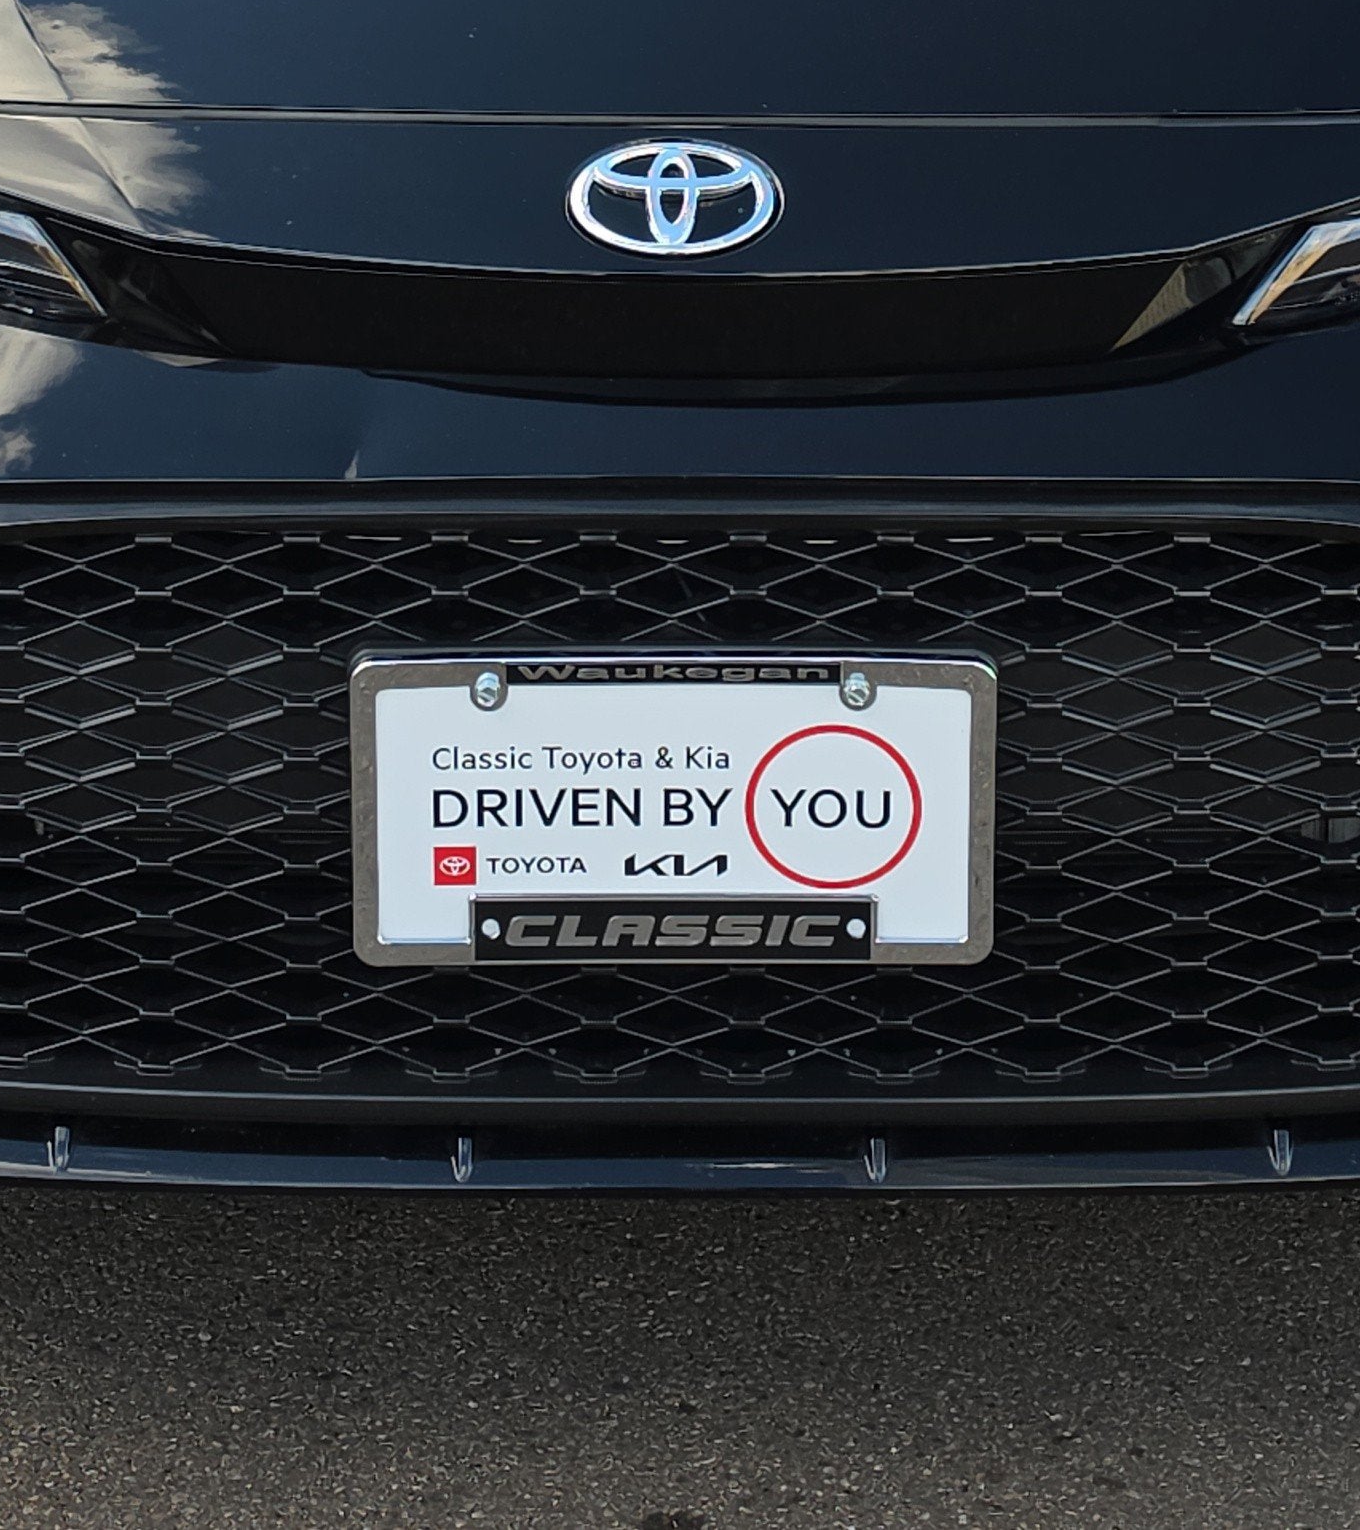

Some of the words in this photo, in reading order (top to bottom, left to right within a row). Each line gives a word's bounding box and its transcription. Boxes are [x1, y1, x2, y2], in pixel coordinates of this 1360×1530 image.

[516, 663, 829, 683] Waukegan
[432, 746, 532, 770] Classic
[542, 746, 643, 776] Toyota
[655, 746, 674, 771] &
[686, 746, 730, 770] Kia
[432, 788, 642, 828] DRIVEN
[662, 788, 733, 828] BY
[771, 788, 892, 829] YOU
[486, 857, 587, 874] TOYOTA
[504, 914, 841, 947] CLASSIC
